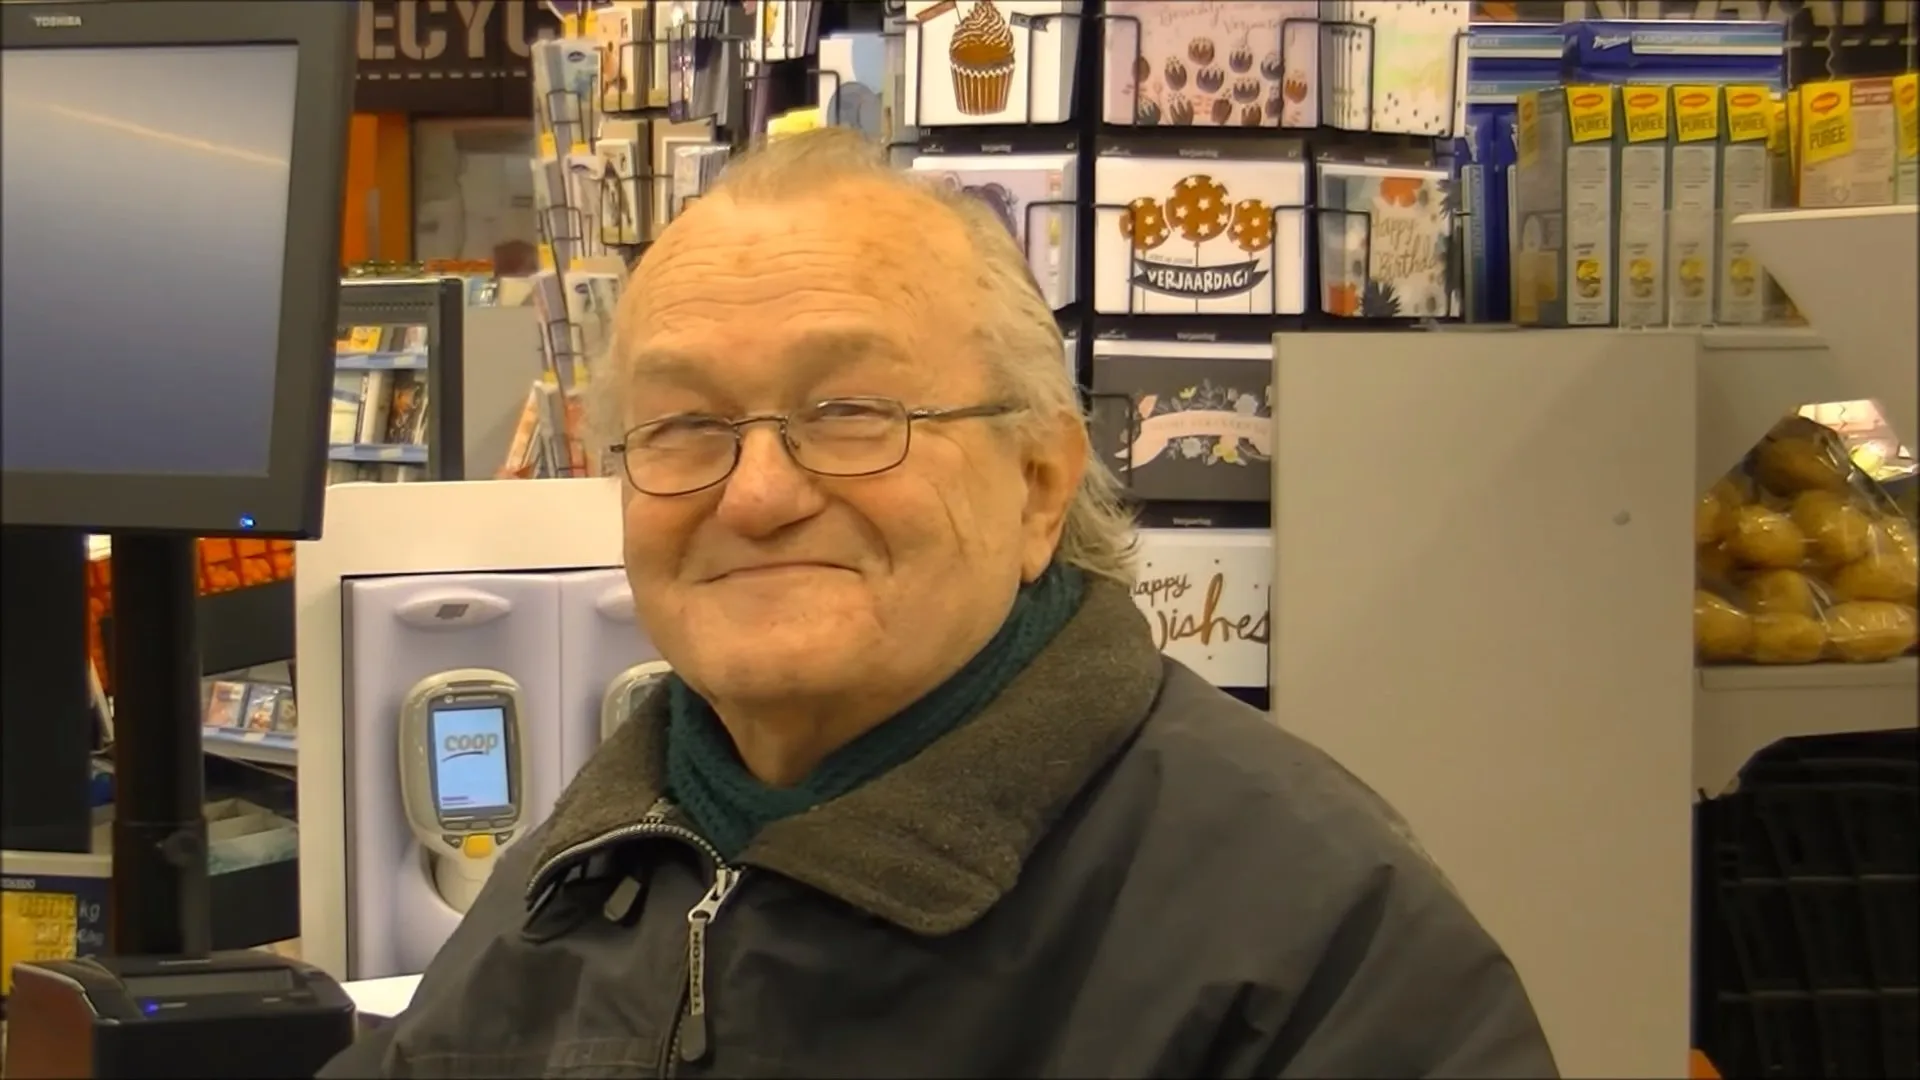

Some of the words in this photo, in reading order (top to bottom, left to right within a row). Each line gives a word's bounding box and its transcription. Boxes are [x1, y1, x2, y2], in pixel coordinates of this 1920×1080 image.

[1809, 124, 1847, 150] PUREE
[1147, 268, 1249, 293] VERJAARDAG!
[444, 733, 499, 756] coop
[692, 931, 701, 1012] TENSON
